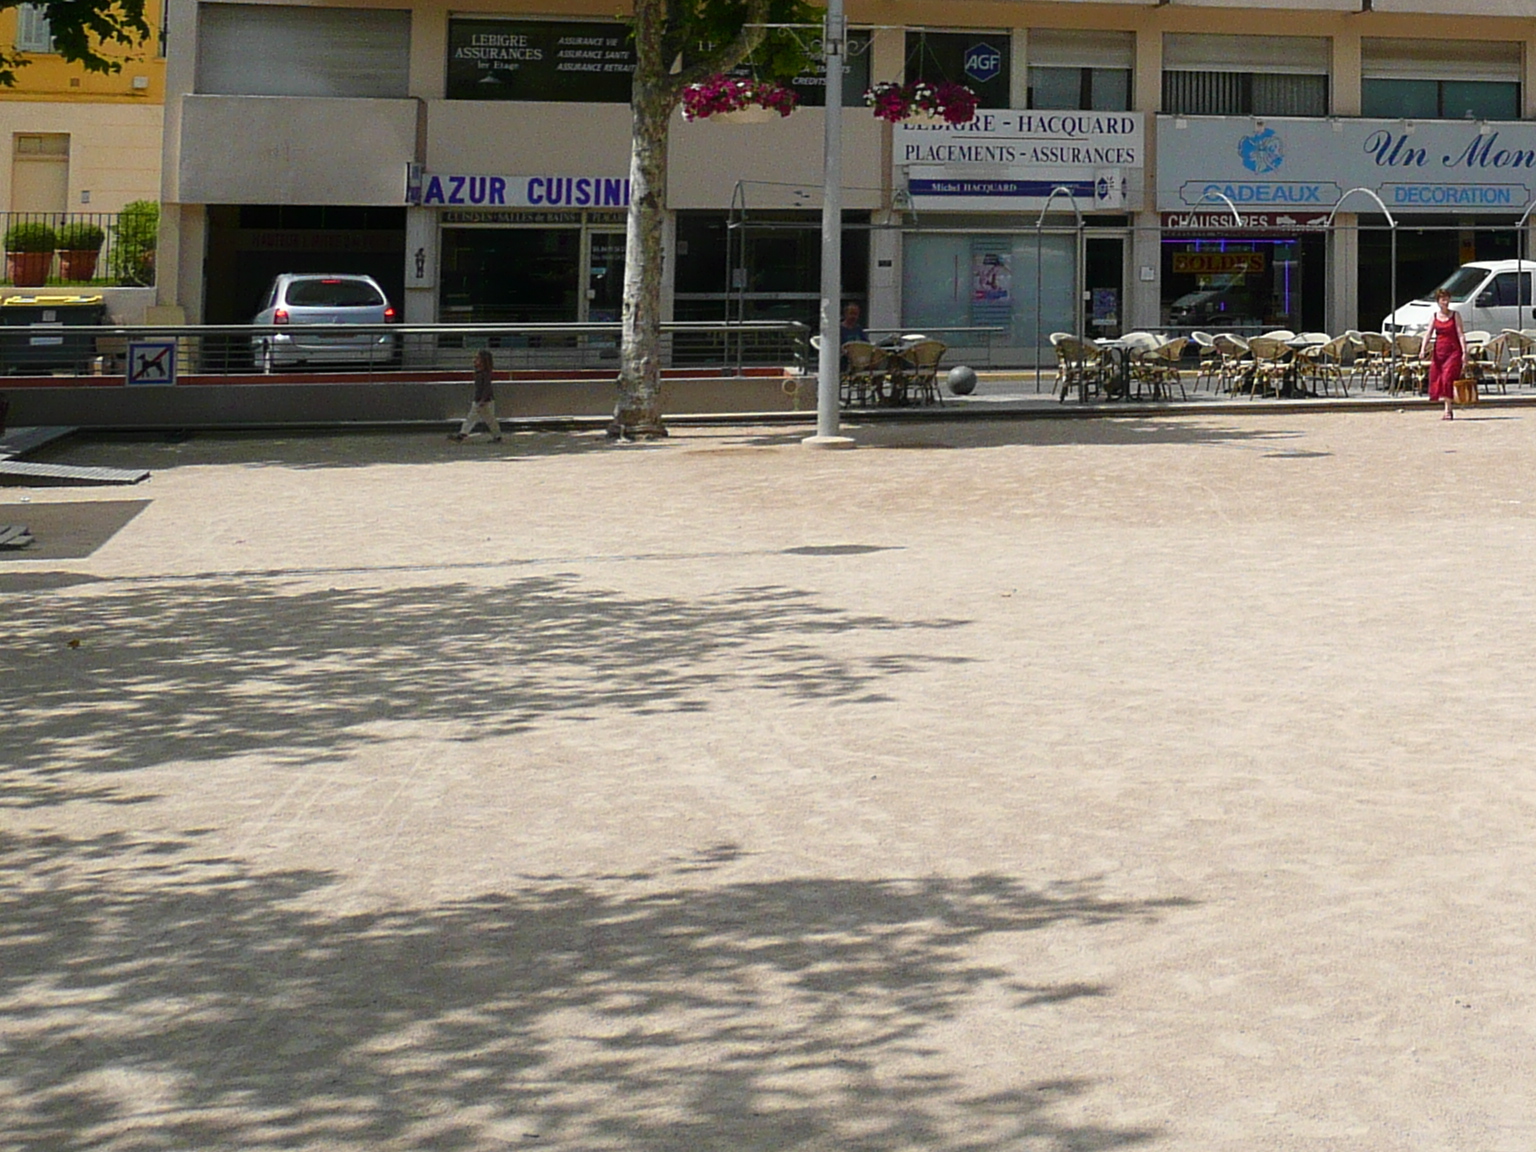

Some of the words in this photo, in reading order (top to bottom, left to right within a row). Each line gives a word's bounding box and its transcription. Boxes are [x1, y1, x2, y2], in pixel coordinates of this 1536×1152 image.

[472, 34, 528, 47] LEBIGRE
[558, 36, 604, 46] ASSURANCE
[455, 47, 543, 60] ASSURANCES
[557, 50, 603, 59] ASSURANCE
[556, 62, 602, 71] ASSURANCE
[603, 63, 636, 73] RETRAIT
[965, 55, 1000, 70] AGF
[1018, 115, 1135, 137] HACQUARD
[905, 144, 1016, 163] PLACEMENTS
[1029, 147, 1135, 164] ASSURANCES
[1363, 129, 1429, 168] Un
[424, 175, 507, 205] AZUR
[963, 182, 1018, 193] HACQUARD
[1203, 184, 1321, 203] CADEAUX
[1394, 185, 1511, 205] DECORATION
[1174, 254, 1264, 271] SOLDES
